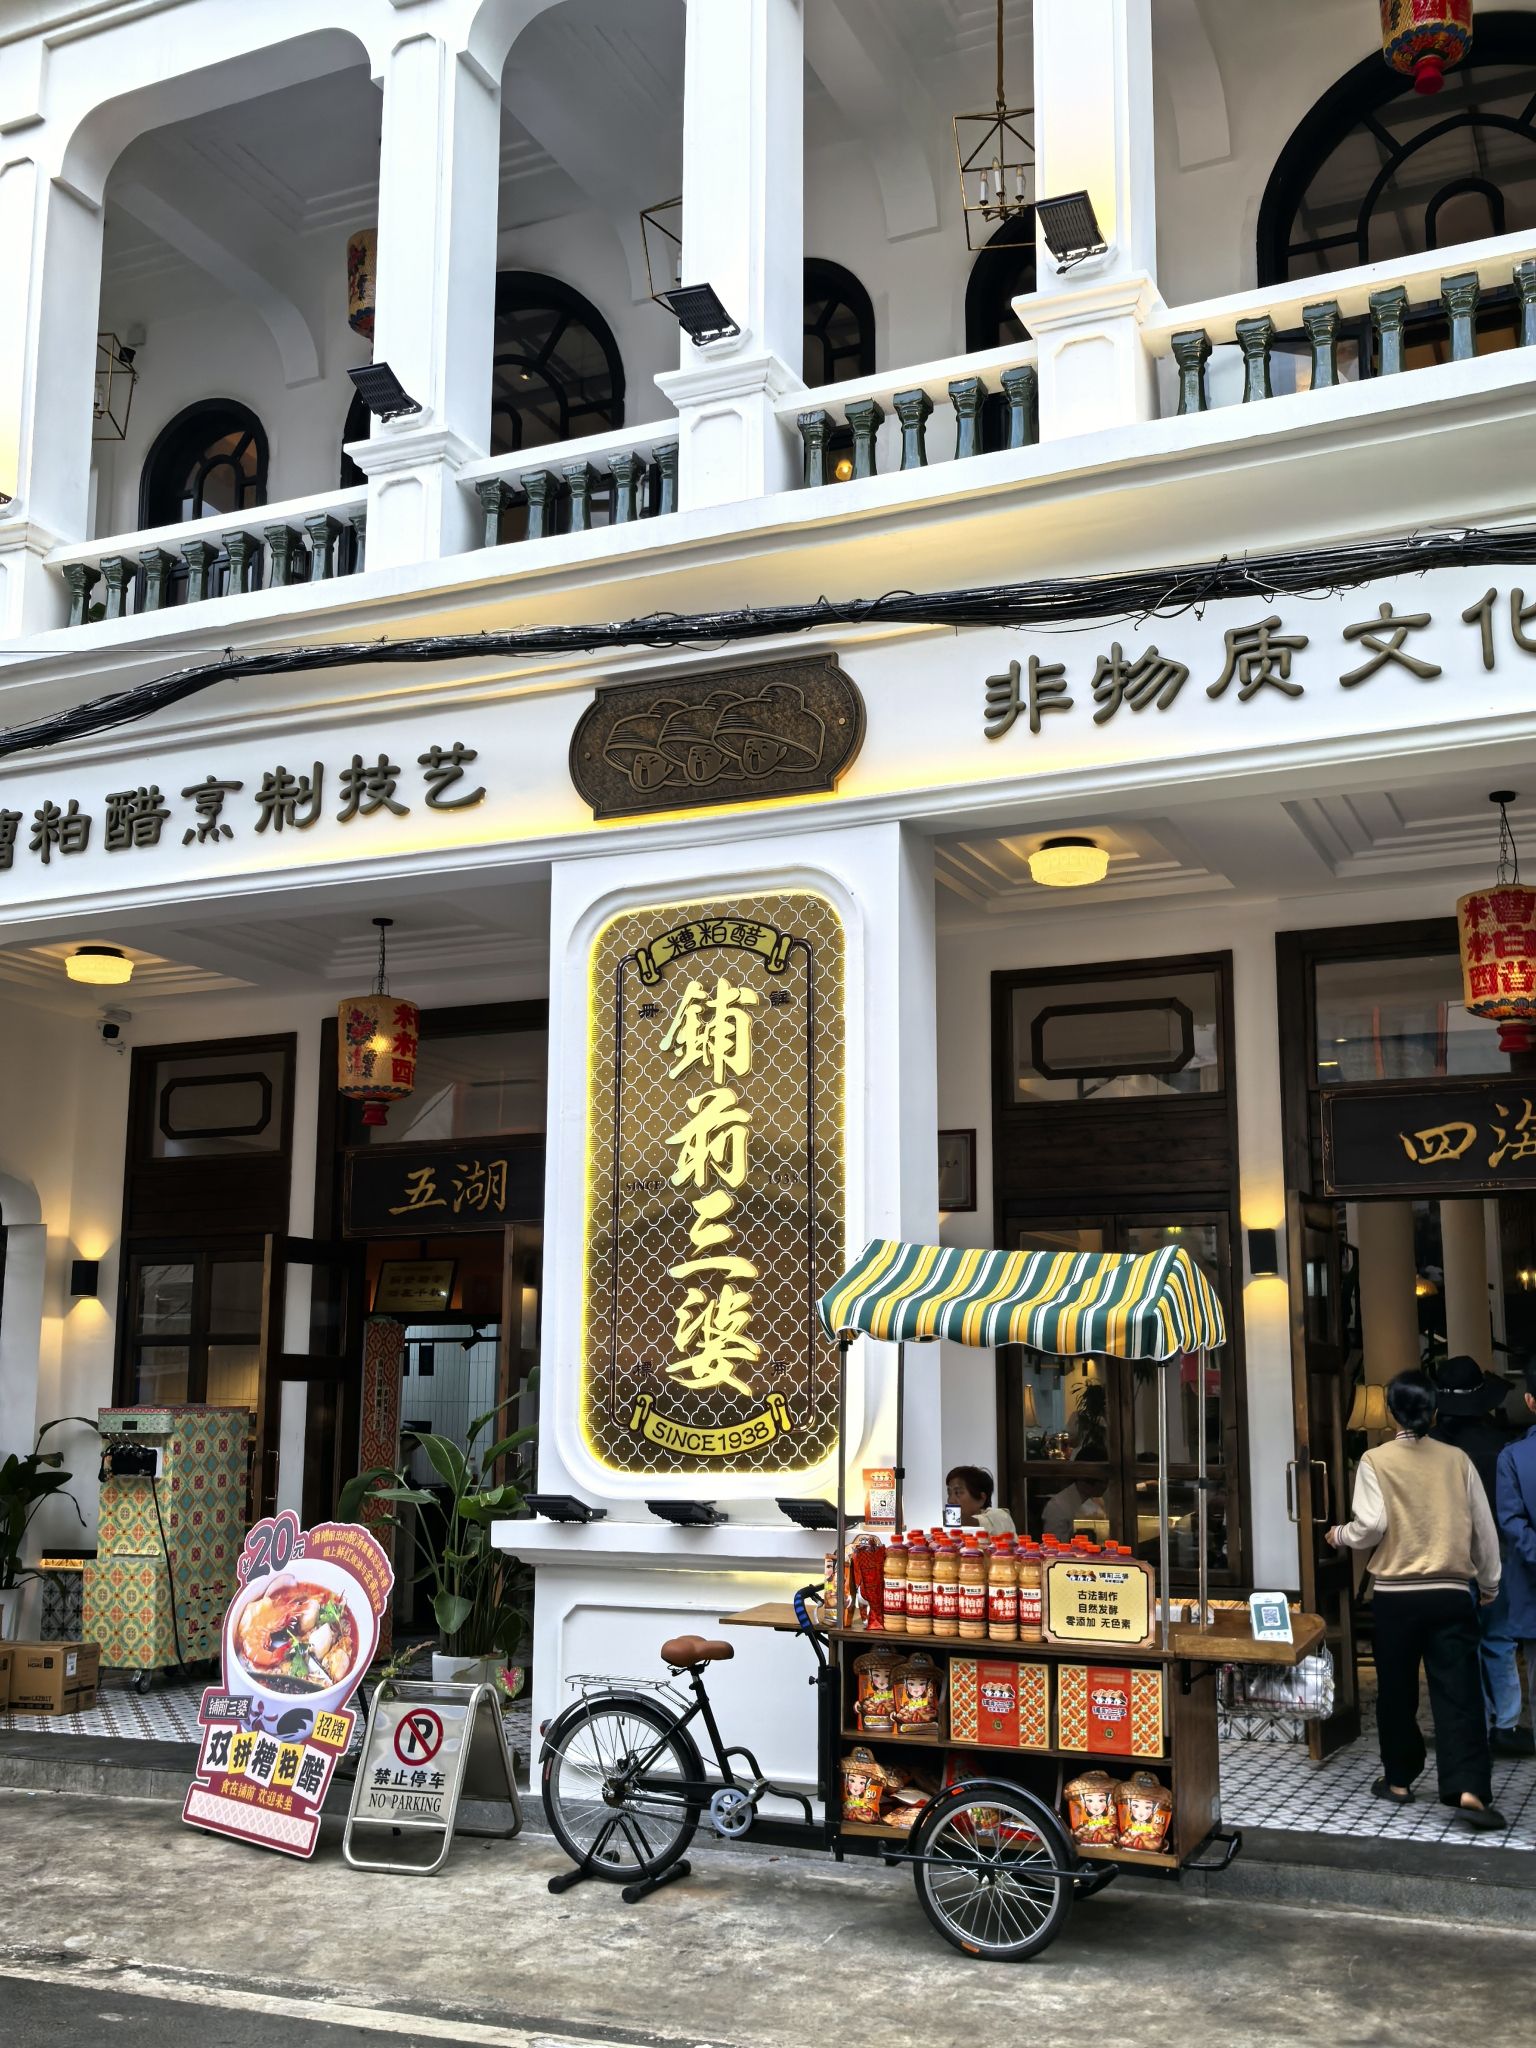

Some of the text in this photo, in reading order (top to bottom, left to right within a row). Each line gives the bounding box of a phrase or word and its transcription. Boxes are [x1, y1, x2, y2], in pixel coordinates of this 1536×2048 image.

[663, 919, 767, 957] 糟粕醋
[388, 1159, 508, 1216] 五湖
[625, 1173, 800, 1192] SINCE 1938
[1078, 1590, 1118, 1602] 古法制作
[1078, 1604, 1118, 1615] 自然发酵
[1065, 1616, 1131, 1629] 零添加 无色素
[316, 1714, 347, 1742] 招牌
[206, 1730, 326, 1796] 双拼糟粕醋
[373, 1768, 446, 1789] 禁止停车
[368, 1793, 442, 1813] NO PARKING
